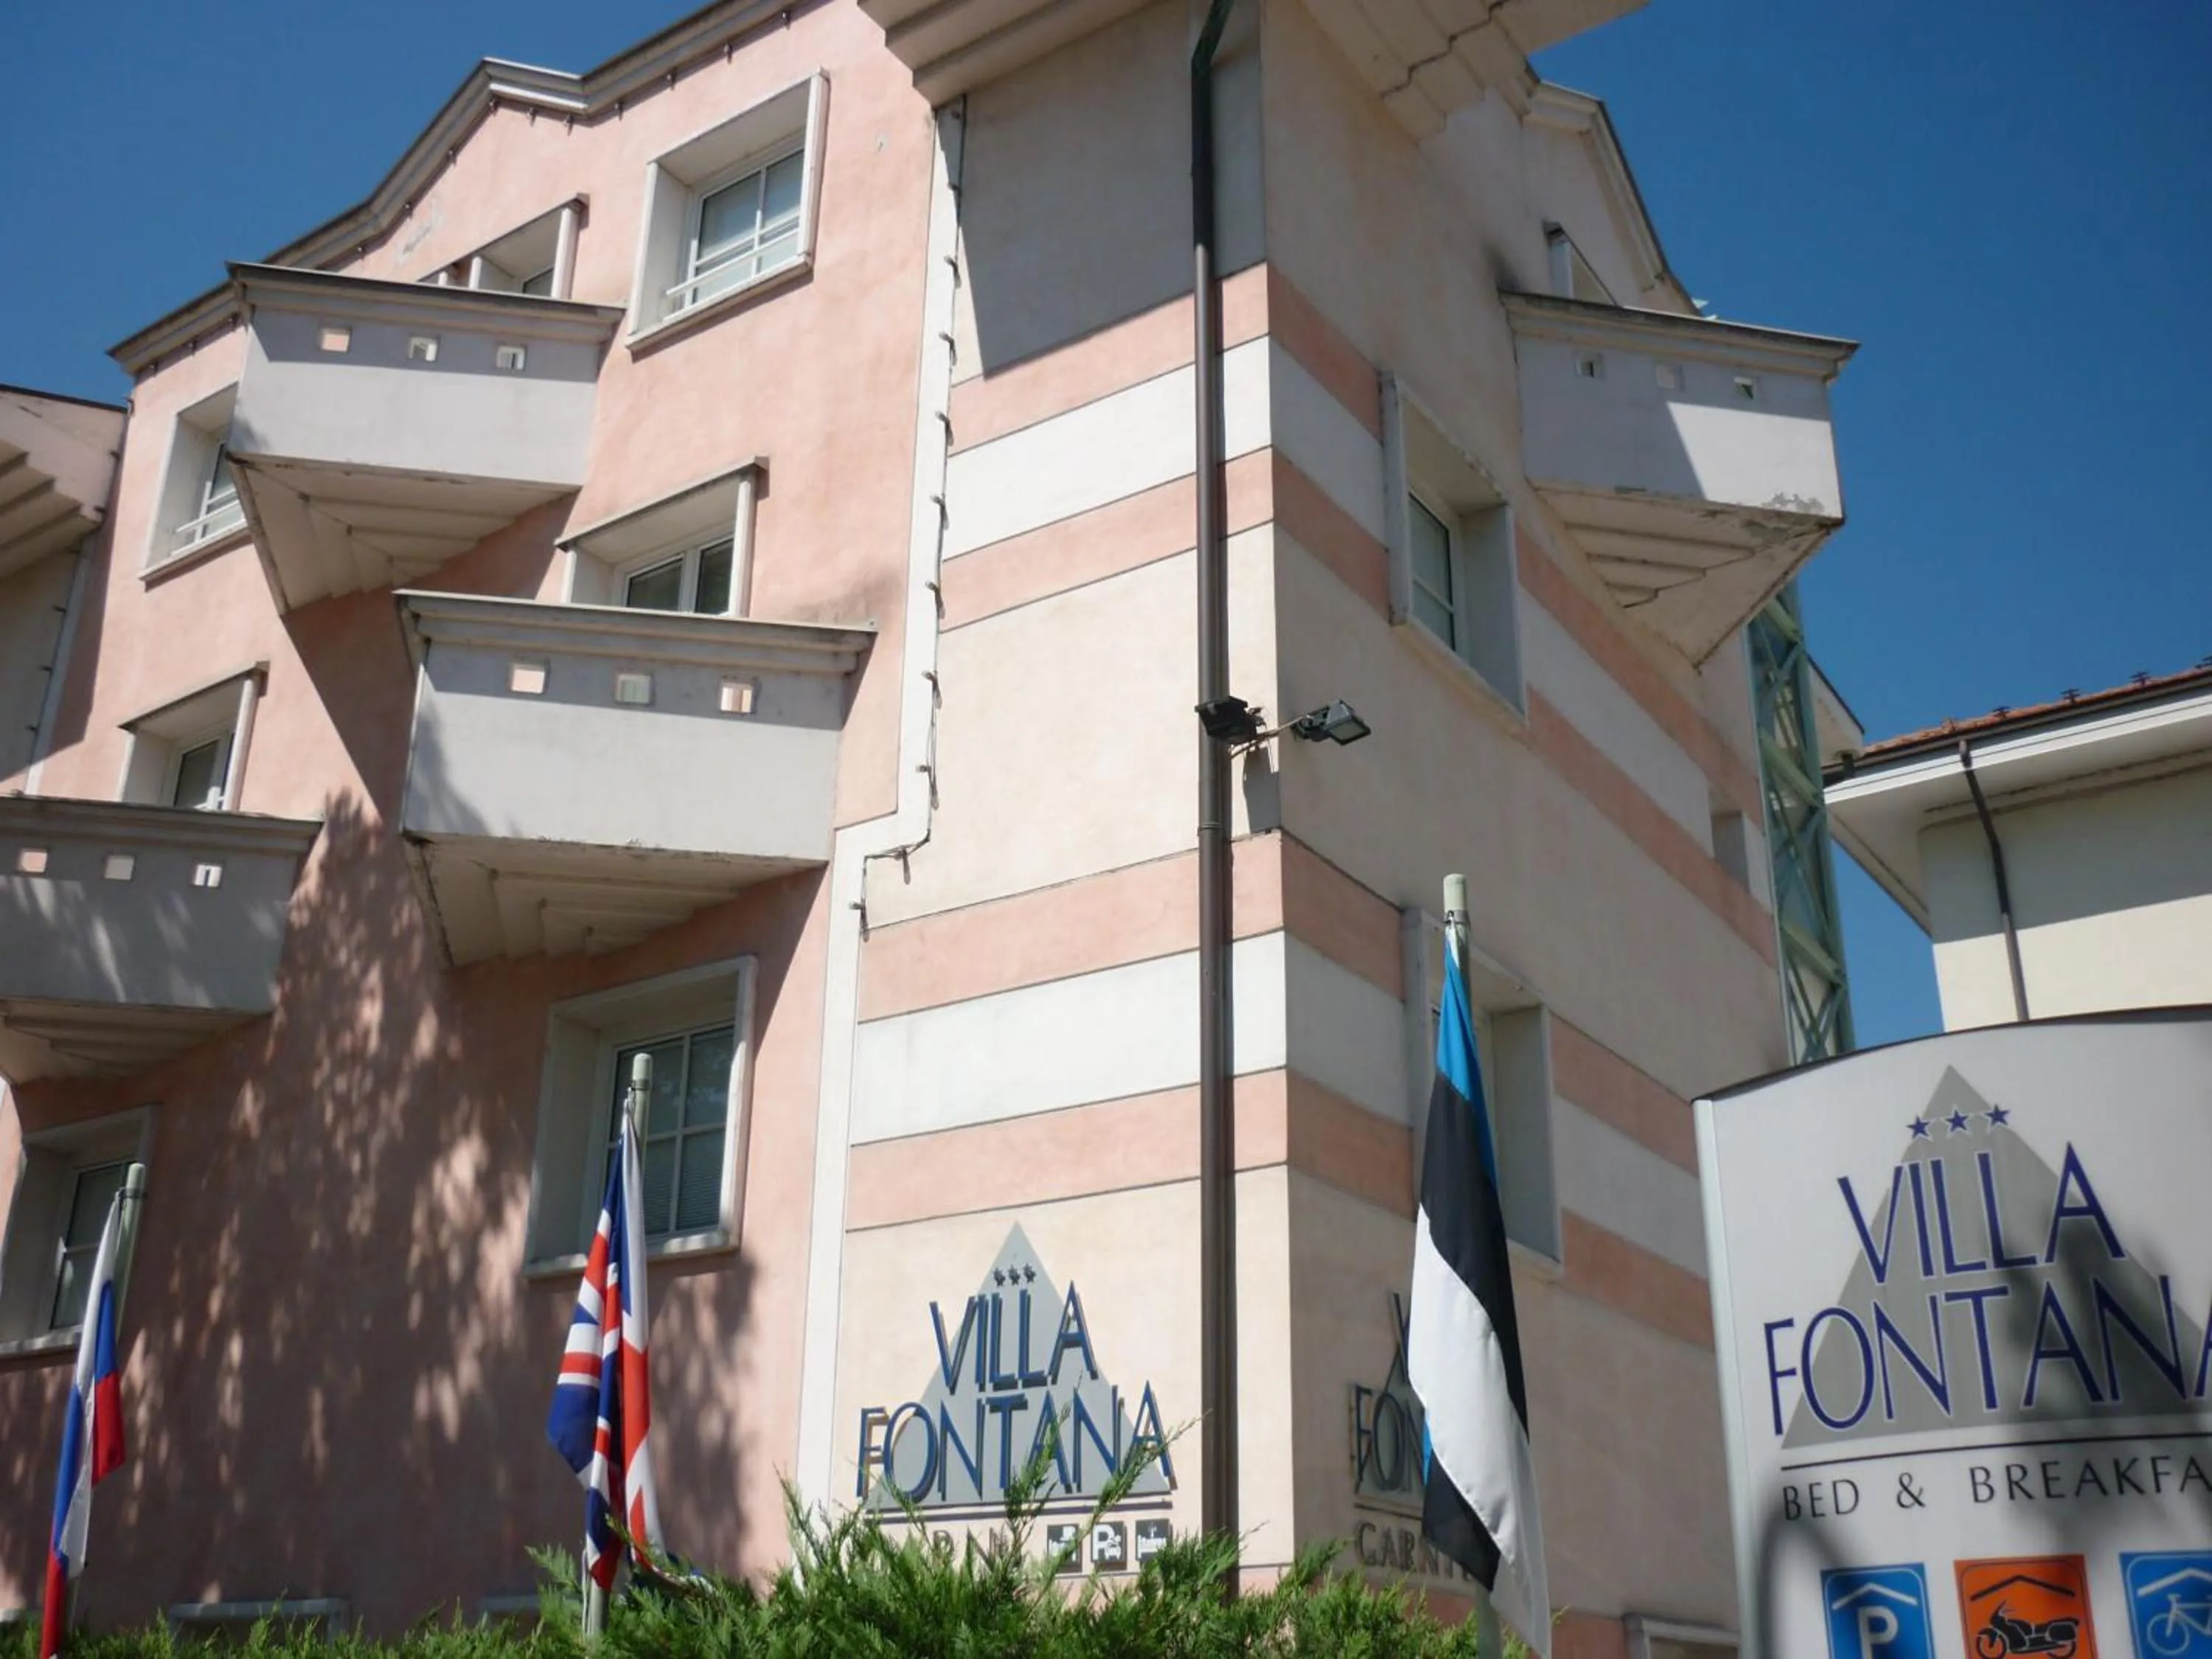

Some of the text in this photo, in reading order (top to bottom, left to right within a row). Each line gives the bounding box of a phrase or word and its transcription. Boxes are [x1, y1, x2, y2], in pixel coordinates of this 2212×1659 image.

[1838, 1142, 2125, 1284] VILLA
[929, 1280, 1098, 1395] VILLA
[1764, 1274, 2212, 1436] FONTAN
[857, 1380, 1177, 1502] FONTANA
[1781, 1478, 1860, 1521] BED
[1895, 1472, 1927, 1509] &
[1857, 1606, 1899, 1659] P
